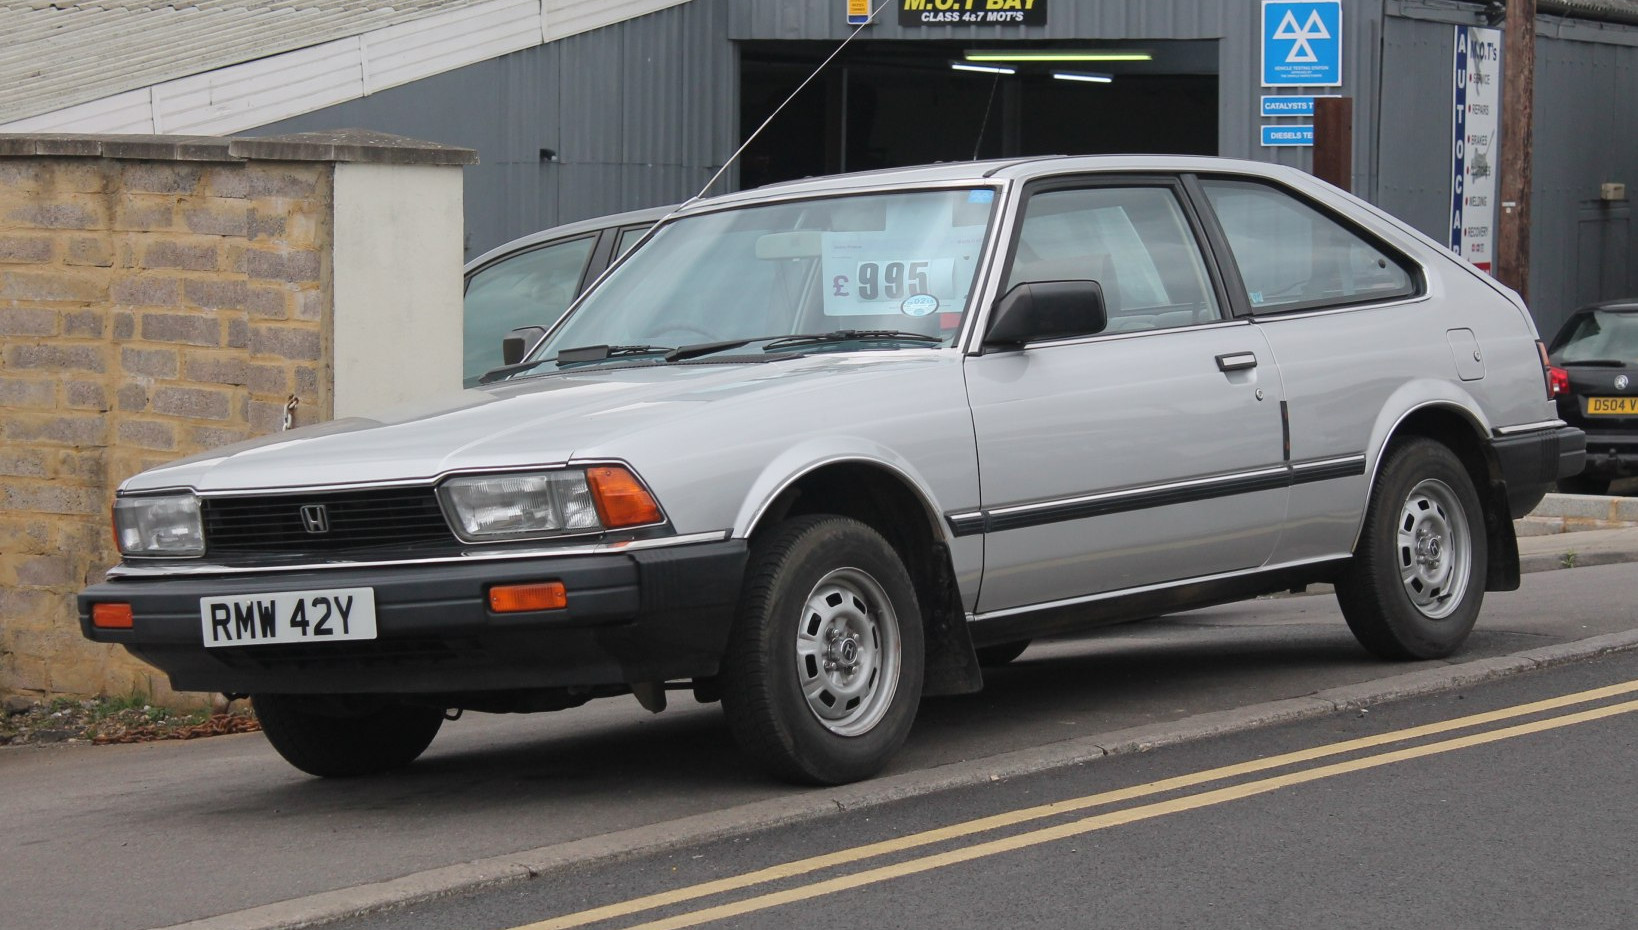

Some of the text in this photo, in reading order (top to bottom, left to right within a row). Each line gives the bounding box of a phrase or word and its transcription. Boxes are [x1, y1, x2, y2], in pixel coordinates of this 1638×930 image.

[921, 11, 1025, 22] CLASS 4&7 MOT'S
[1264, 102, 1308, 110] CATALYSTS
[1270, 132, 1302, 140] DIESELS
[858, 261, 929, 300] 995
[210, 595, 353, 641] RMW 42Y
